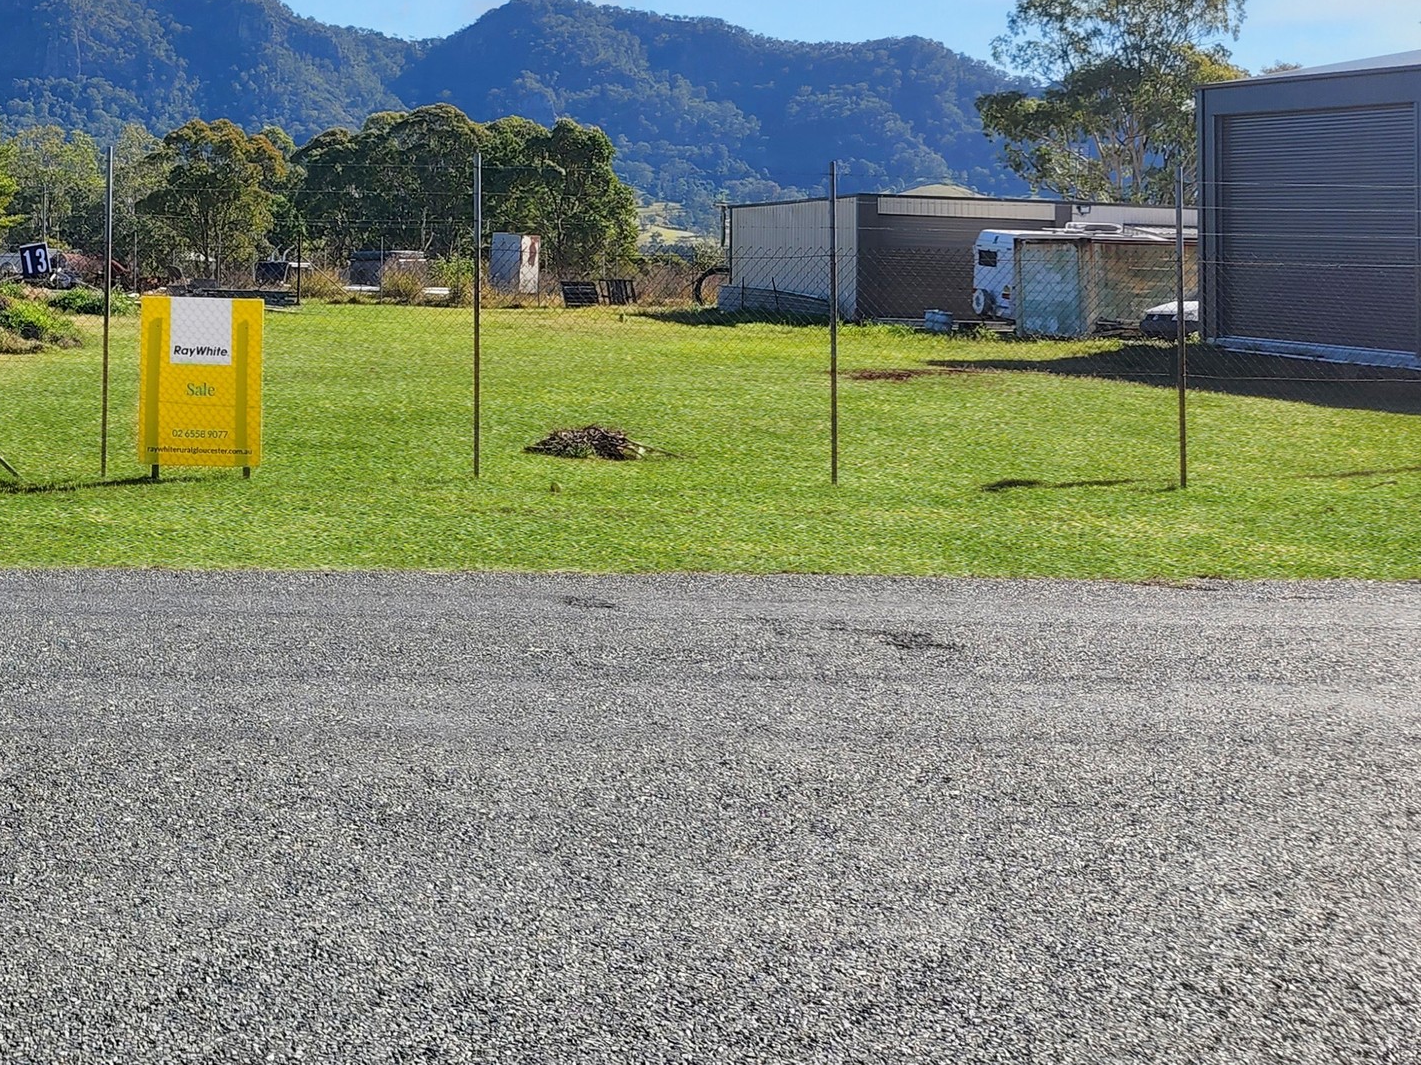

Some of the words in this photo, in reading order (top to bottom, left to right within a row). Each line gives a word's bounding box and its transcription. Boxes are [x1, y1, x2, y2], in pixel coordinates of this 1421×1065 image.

[23, 248, 47, 274] 13
[186, 382, 215, 397] Sale
[171, 429, 183, 438] 02
[184, 429, 206, 438] 6558
[207, 430, 229, 439] 9077
[147, 446, 253, 455] raywhiteruralgloucester.com.au
